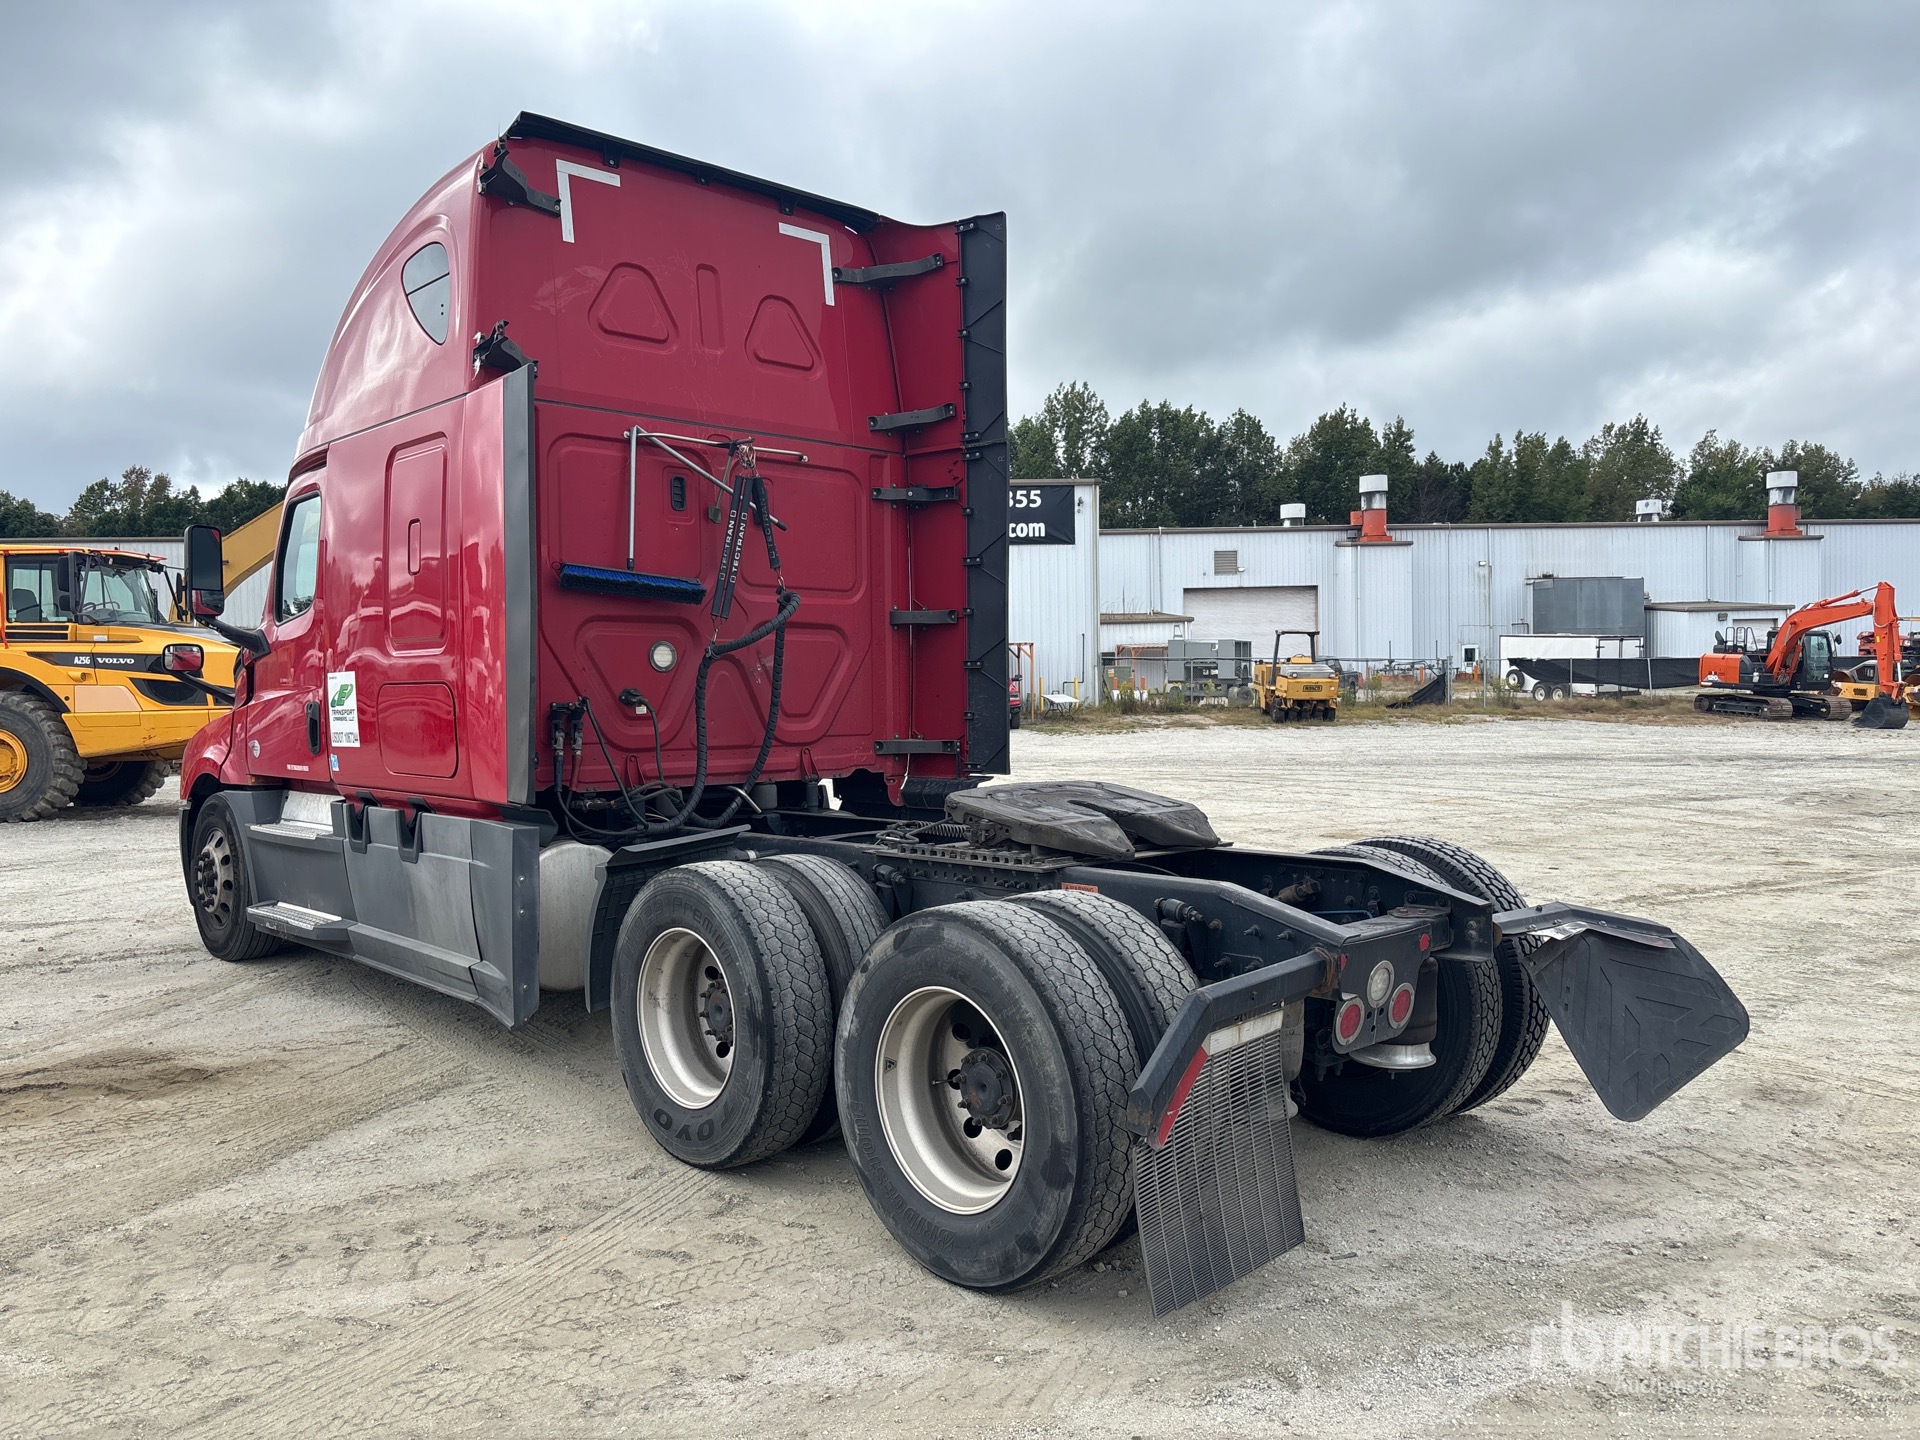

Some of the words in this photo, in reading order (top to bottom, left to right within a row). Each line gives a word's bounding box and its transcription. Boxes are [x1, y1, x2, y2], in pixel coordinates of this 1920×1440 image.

[721, 519, 735, 569] TECTRAN
[732, 522, 747, 573] TECTRAN
[654, 1101, 740, 1142] TOYO
